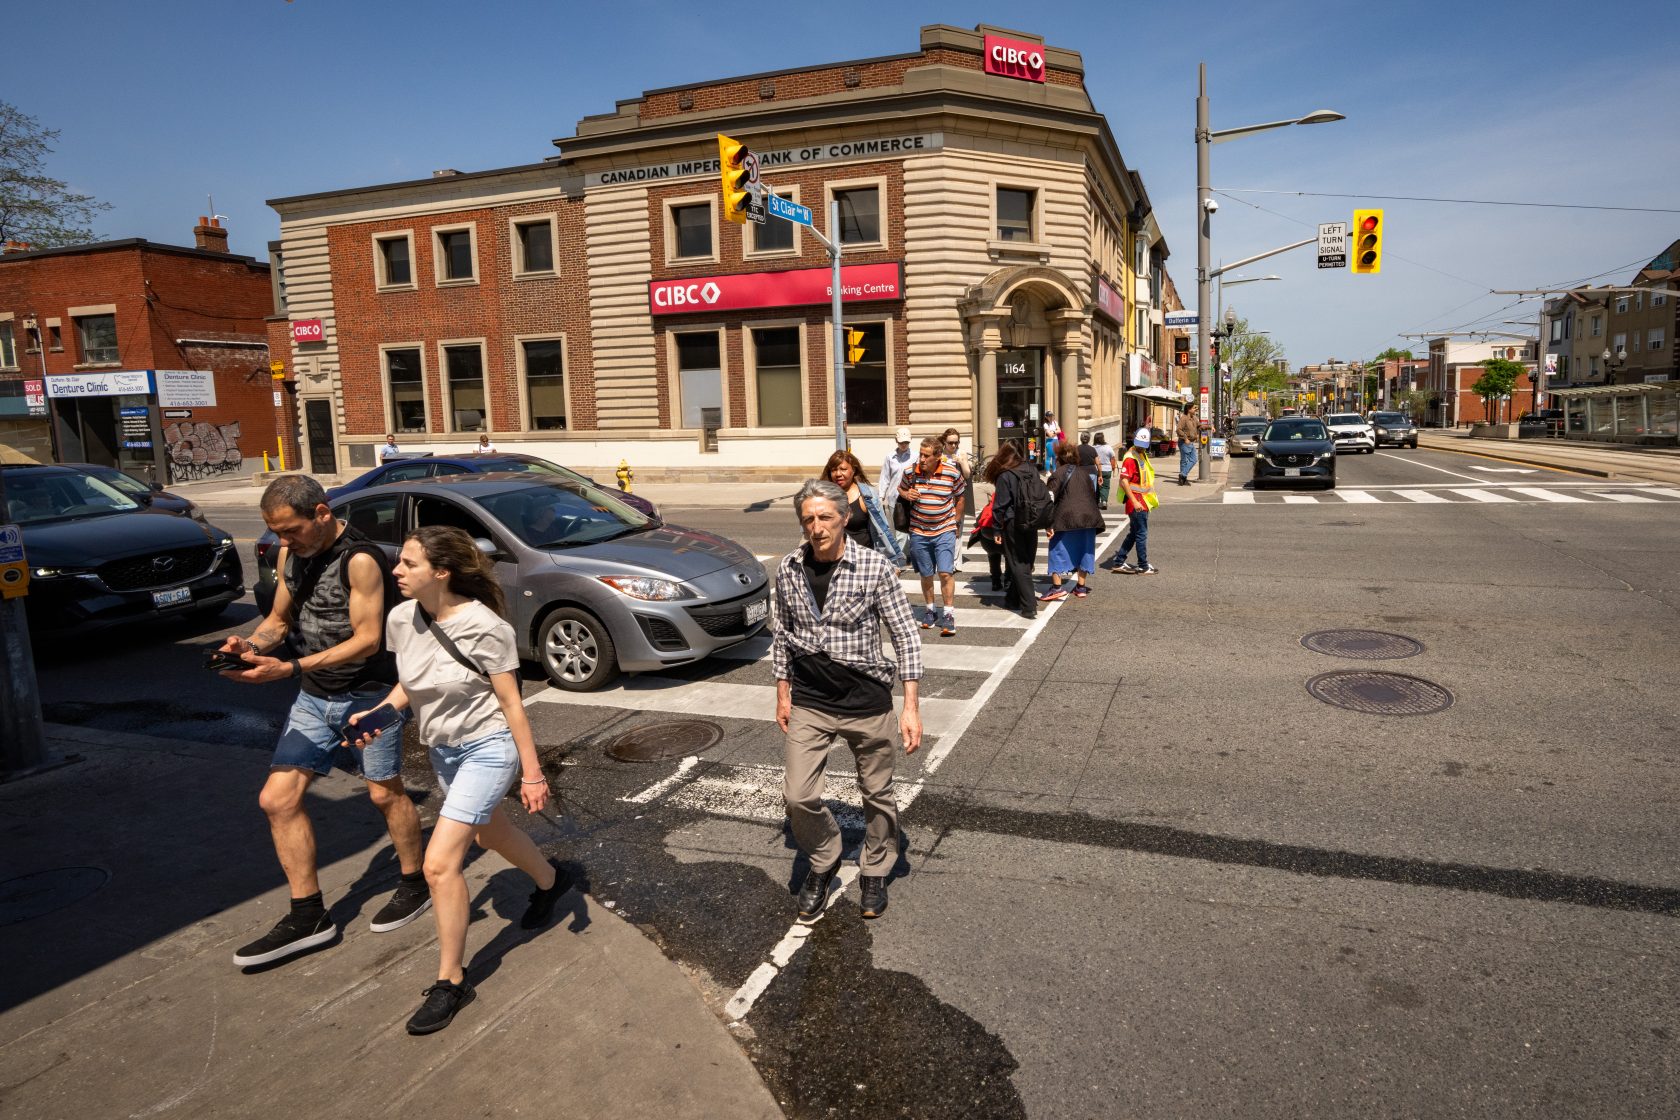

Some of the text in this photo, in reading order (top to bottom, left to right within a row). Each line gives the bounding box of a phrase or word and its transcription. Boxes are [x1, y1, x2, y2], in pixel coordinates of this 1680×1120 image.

[992, 45, 1028, 66] CIBC
[601, 137, 924, 184] CANADIAN IMPER ANK OF COMMERCE
[750, 205, 759, 214] TTC
[771, 197, 780, 212] St
[781, 201, 796, 217] Clair
[803, 208, 809, 222] W
[1323, 226, 1342, 235] LEFT
[1322, 236, 1343, 244] TURN
[1320, 246, 1344, 254] SIGNAL
[863, 283, 895, 294] Centre
[654, 284, 700, 307] CIBC
[295, 326, 313, 336] CIBC
[1181, 353, 1187, 364] 8
[1004, 363, 1026, 374] 1164
[25, 384, 42, 392] SOLD
[52, 381, 109, 394] Denture Clinic
